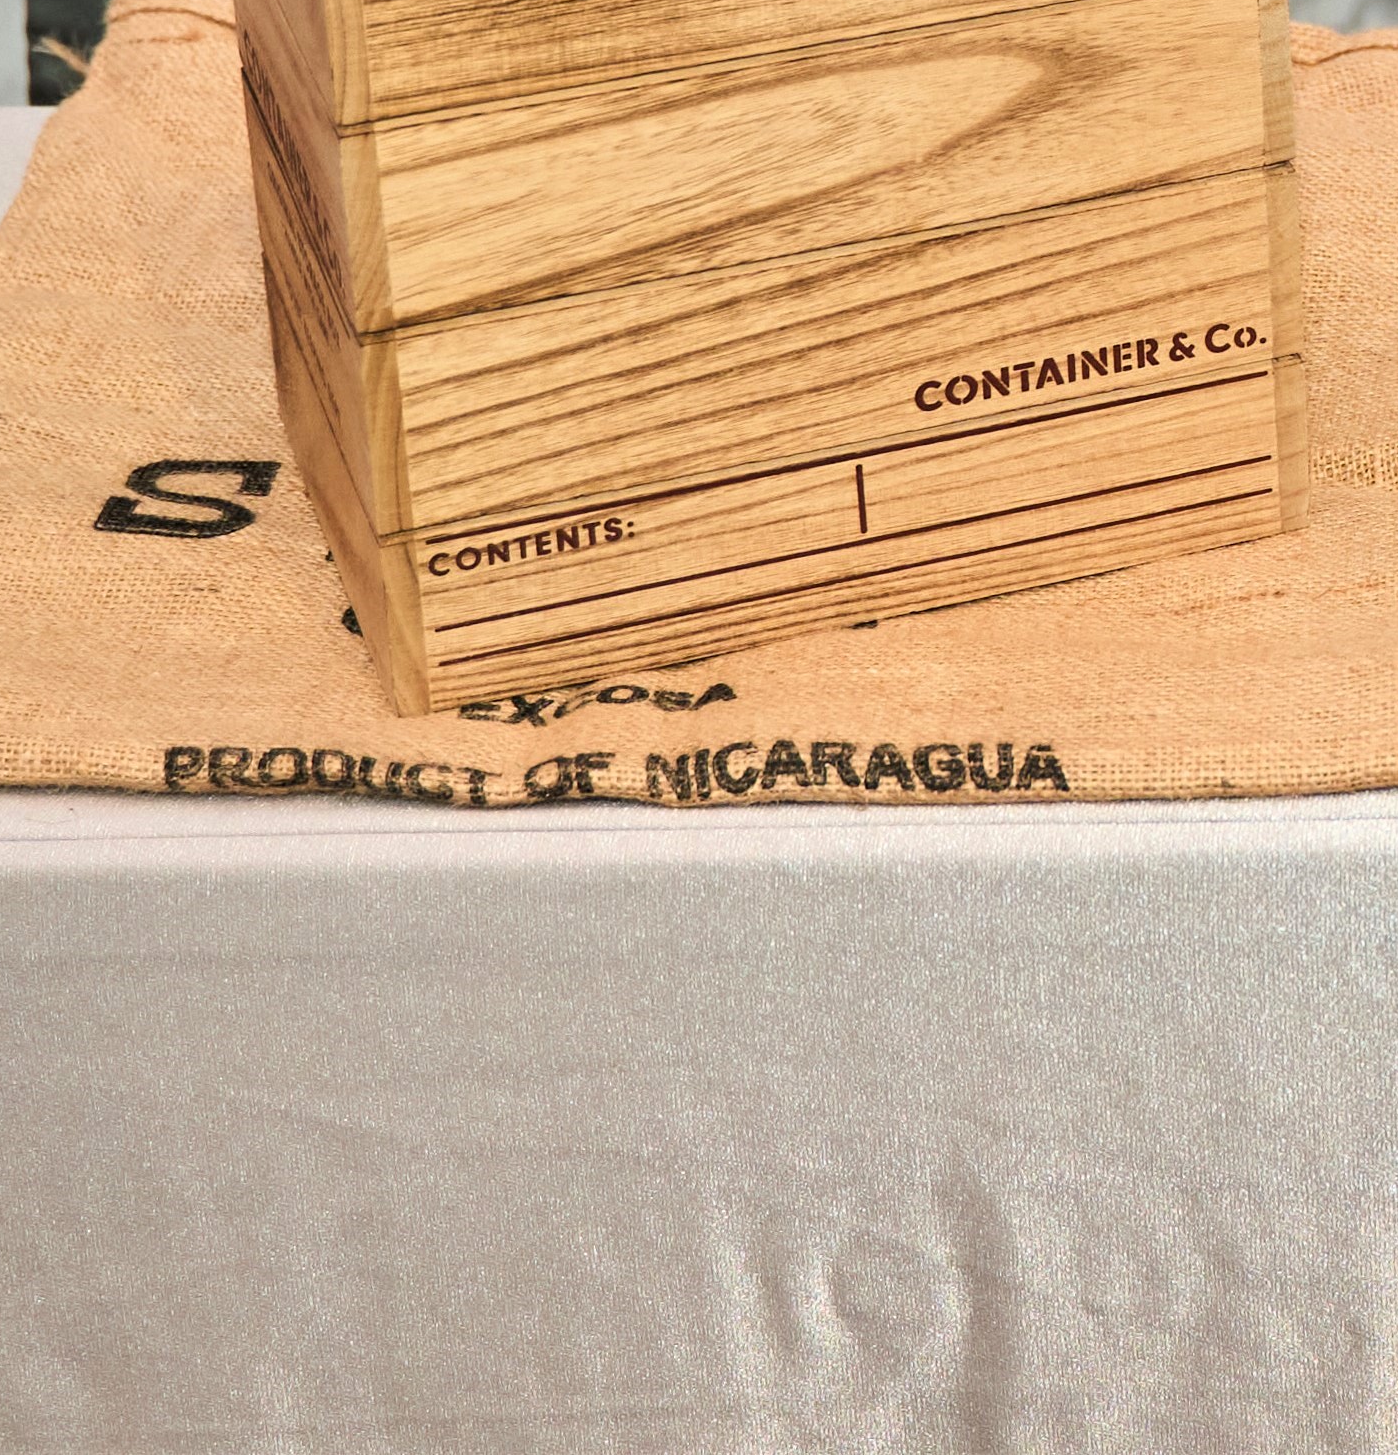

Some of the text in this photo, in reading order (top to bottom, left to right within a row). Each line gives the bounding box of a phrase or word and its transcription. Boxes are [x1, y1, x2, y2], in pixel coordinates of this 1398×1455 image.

[914, 323, 1268, 412] CONTAINER & Co.
[428, 517, 635, 577] CONTENTS:
[164, 740, 1070, 806] PRODUCT OF NICARAGUA
